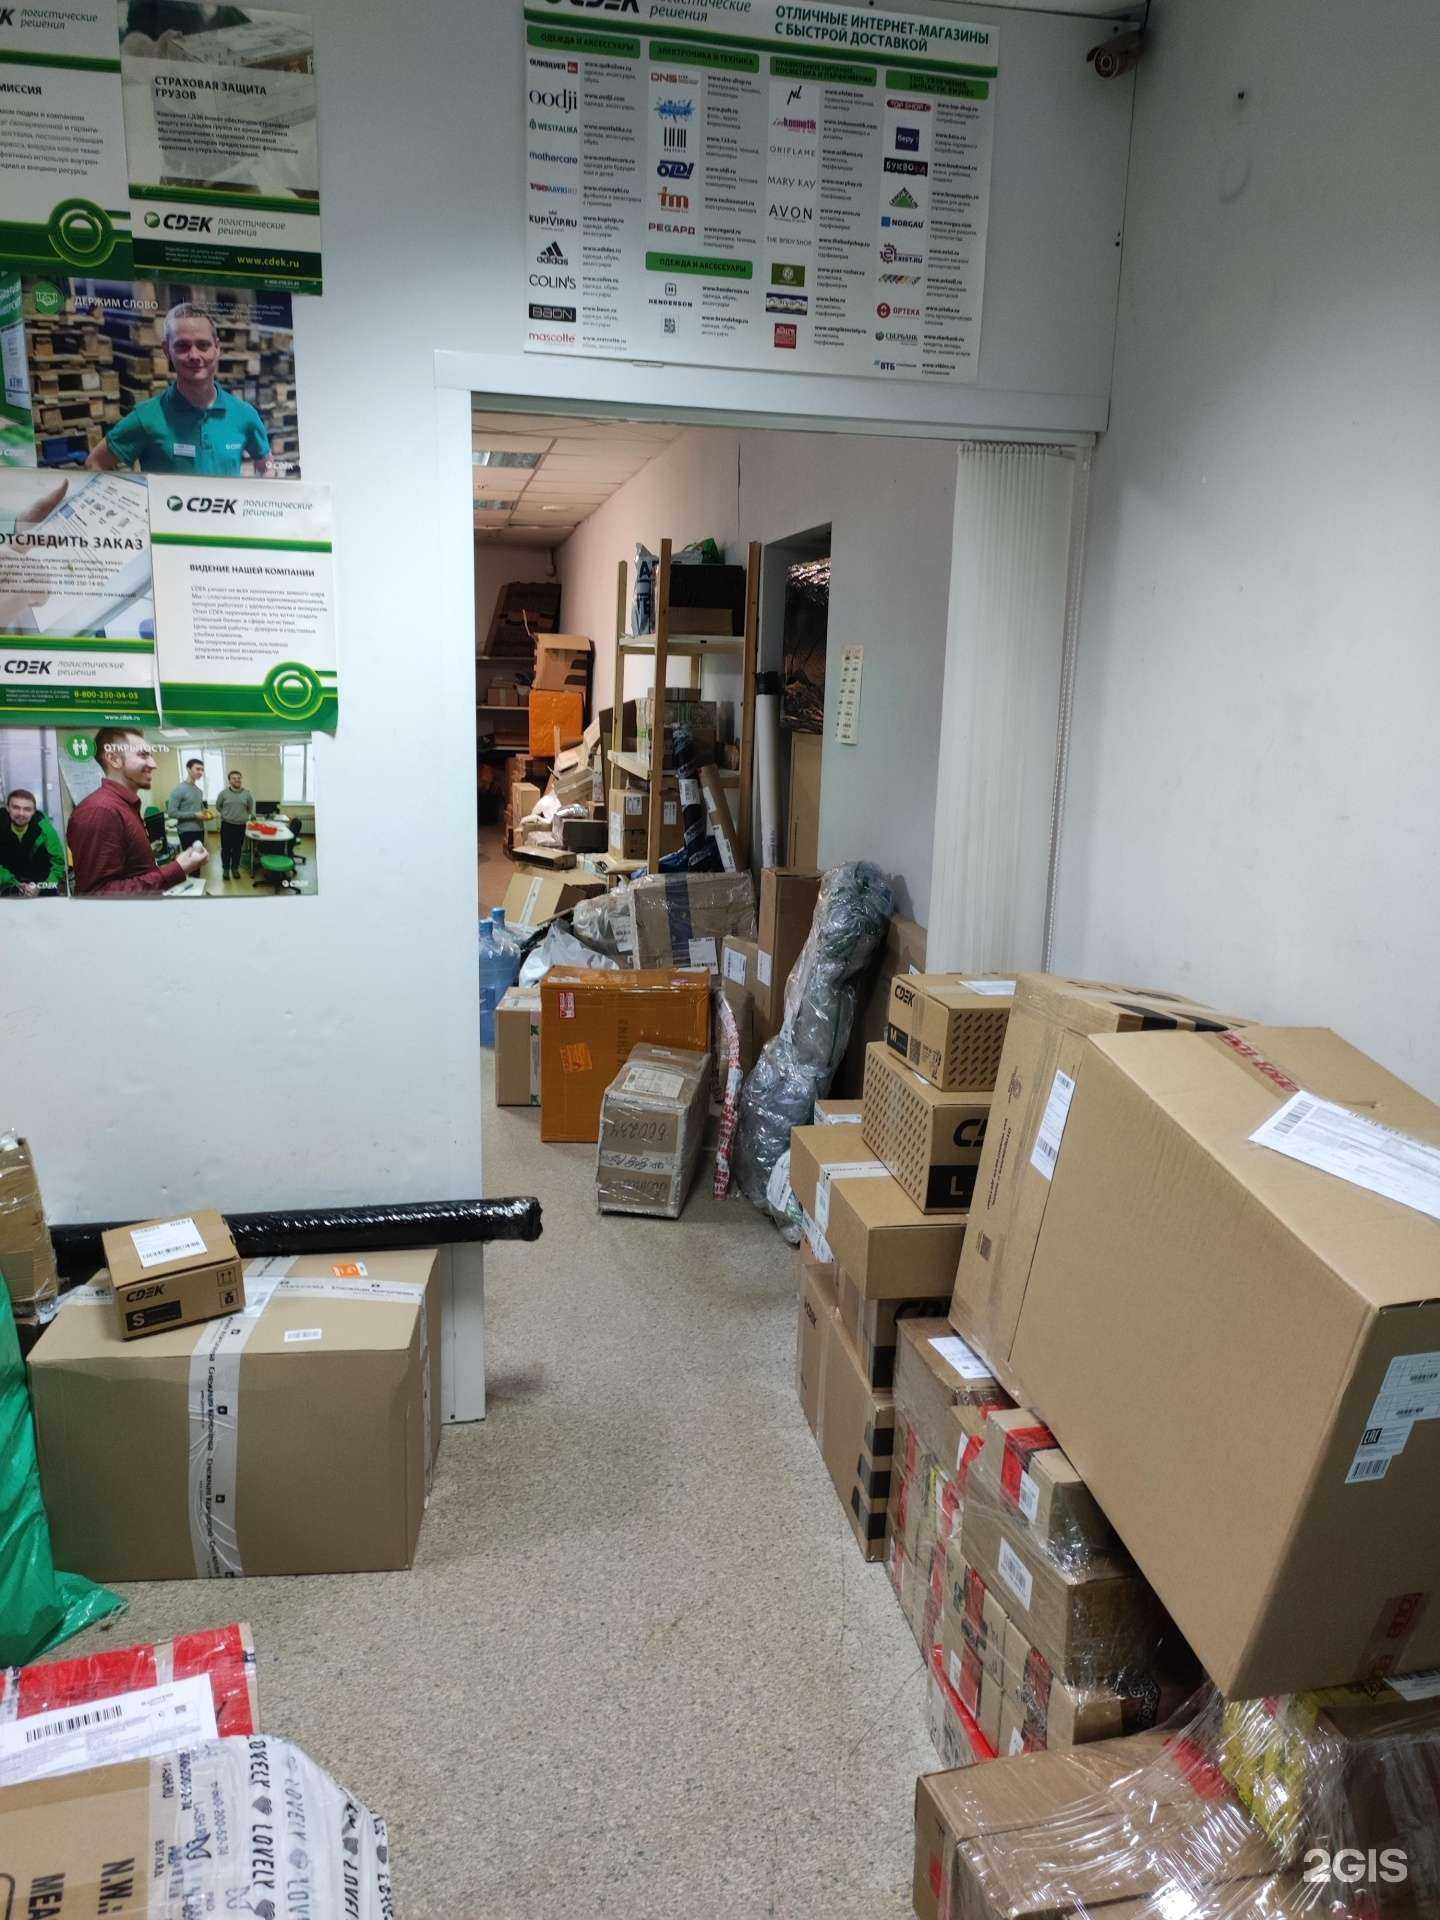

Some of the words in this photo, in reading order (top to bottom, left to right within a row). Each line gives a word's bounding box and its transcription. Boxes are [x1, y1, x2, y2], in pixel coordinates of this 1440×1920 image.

[20, 8, 98, 23] логистические
[650, 5, 708, 22] решения
[20, 19, 66, 30] решения
[775, 5, 848, 27] ОТЛИЧНЫЕ
[851, 14, 990, 45] ИНТЕРНЕТ-МАГАЗИНЫ
[774, 22, 784, 34] С
[786, 23, 848, 43] БЫСТРОЙ
[850, 33, 928, 52] ДОСТАВКОЙ
[154, 76, 220, 90] СТРАХОВАЯ
[221, 82, 267, 96] ЗАЩИТА
[651, 73, 677, 85] DNS
[155, 88, 197, 100] ГРУЗОВ
[529, 89, 577, 113] oodji
[529, 152, 578, 164] mothercare
[770, 145, 816, 157] ORIFLAME
[768, 176, 795, 188] MARY
[798, 179, 816, 190] KAY
[769, 204, 813, 220] AVON
[163, 213, 213, 233] CDEK
[217, 217, 286, 231] логистические
[891, 219, 924, 229] NORGAU
[217, 226, 258, 238] решения
[236, 254, 300, 269] www.cdek.ru
[537, 255, 568, 266] adidas
[529, 274, 576, 290] COLIN'S
[74, 295, 120, 309] ДЕРЖИМ
[122, 299, 159, 310] СЛОВО
[649, 298, 693, 308] HENDERSON
[529, 331, 575, 344] mascotte
[186, 497, 238, 515] CDEK
[243, 499, 313, 512] логистические
[243, 509, 284, 518] решения
[0, 532, 88, 549] ОТСЛЕДИТЬ
[94, 536, 143, 550] ЗАКАЗ
[189, 563, 230, 574] ВИДЕНИЕ
[231, 565, 263, 575] НАШЕЙ
[264, 567, 316, 577] КОМПАНИИ
[4, 659, 52, 675] CDEK
[104, 743, 170, 754] ОТКРЫТОСТЬ
[895, 985, 915, 1008] CDEK
[951, 1176, 963, 1195] L
[126, 1284, 165, 1303] CDEK
[132, 1312, 145, 1327] S
[249, 1740, 273, 1790] OVELY
[284, 1778, 308, 1842] LOVELY
[252, 1824, 276, 1890] LOVELY
[28, 1872, 66, 1920] MEA
